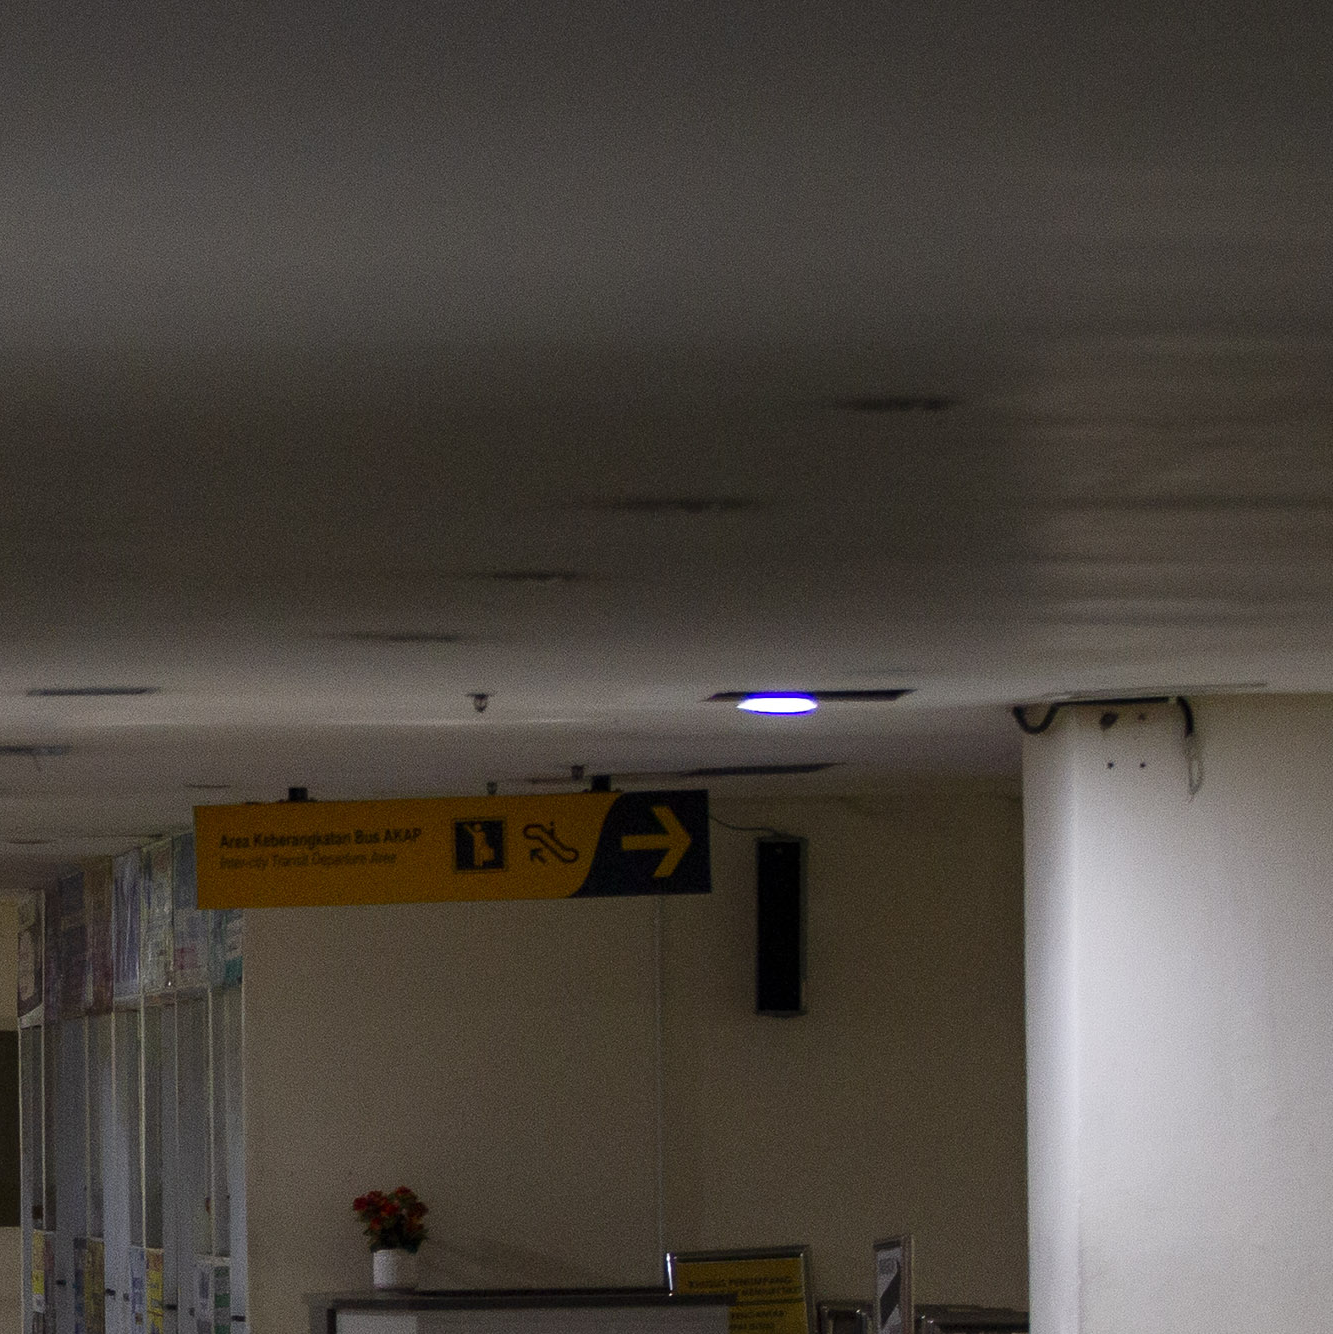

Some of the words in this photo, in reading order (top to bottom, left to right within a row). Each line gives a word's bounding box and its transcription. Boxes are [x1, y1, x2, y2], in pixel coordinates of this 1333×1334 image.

[220, 833, 250, 848] Area
[253, 831, 352, 850] Keberangkatan
[355, 829, 381, 844] Bus
[383, 827, 422, 843] AKAP
